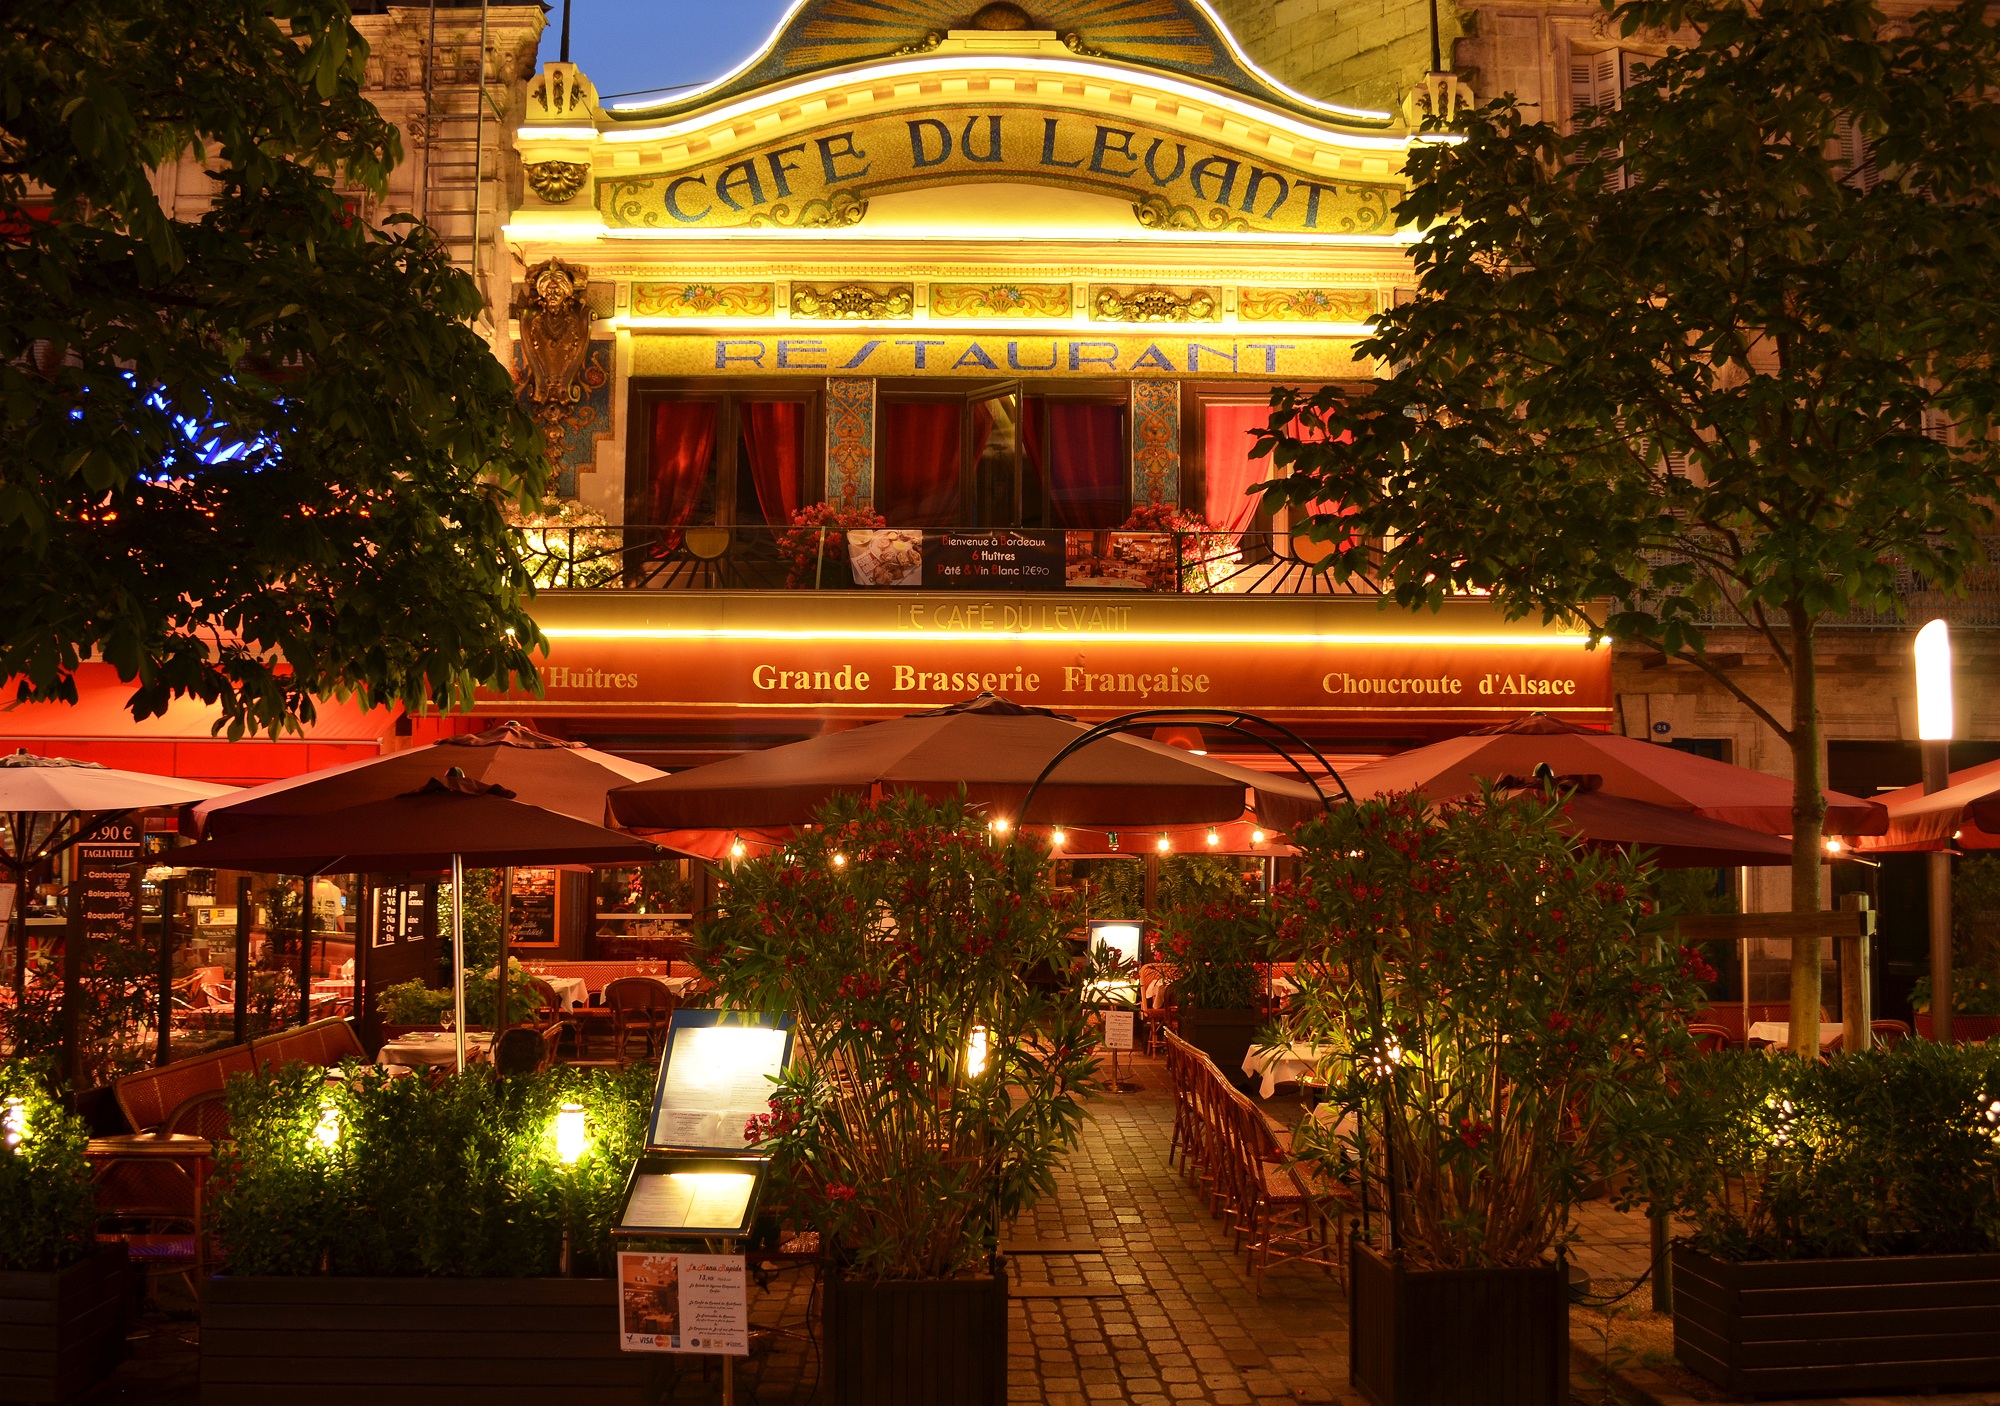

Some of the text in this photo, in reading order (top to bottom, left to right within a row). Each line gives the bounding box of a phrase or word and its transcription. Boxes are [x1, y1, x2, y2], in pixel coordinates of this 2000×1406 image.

[664, 115, 1337, 228] CAFE DU LEVANT
[715, 339, 1296, 373] RESTAURANT
[942, 536, 1046, 547] Bienvenue à Bordeaux
[971, 551, 1016, 561] 6 Huîtres
[937, 564, 1050, 577] Pâté & Vin Blanc 12€90
[897, 602, 1132, 632] LE CAFÉ DU LEVANT
[752, 664, 1210, 698] Grande Brasserie Française
[1322, 672, 1576, 696] Choucroute d'Alsace
[1656, 724, 1668, 732] 24
[122, 825, 133, 841] €
[83, 849, 134, 858] TAGLIATELLE
[88, 871, 131, 879] Carbonara
[87, 890, 131, 899] Bolognaise
[86, 912, 125, 921] Roquefort
[639, 1336, 654, 1344] VISA
